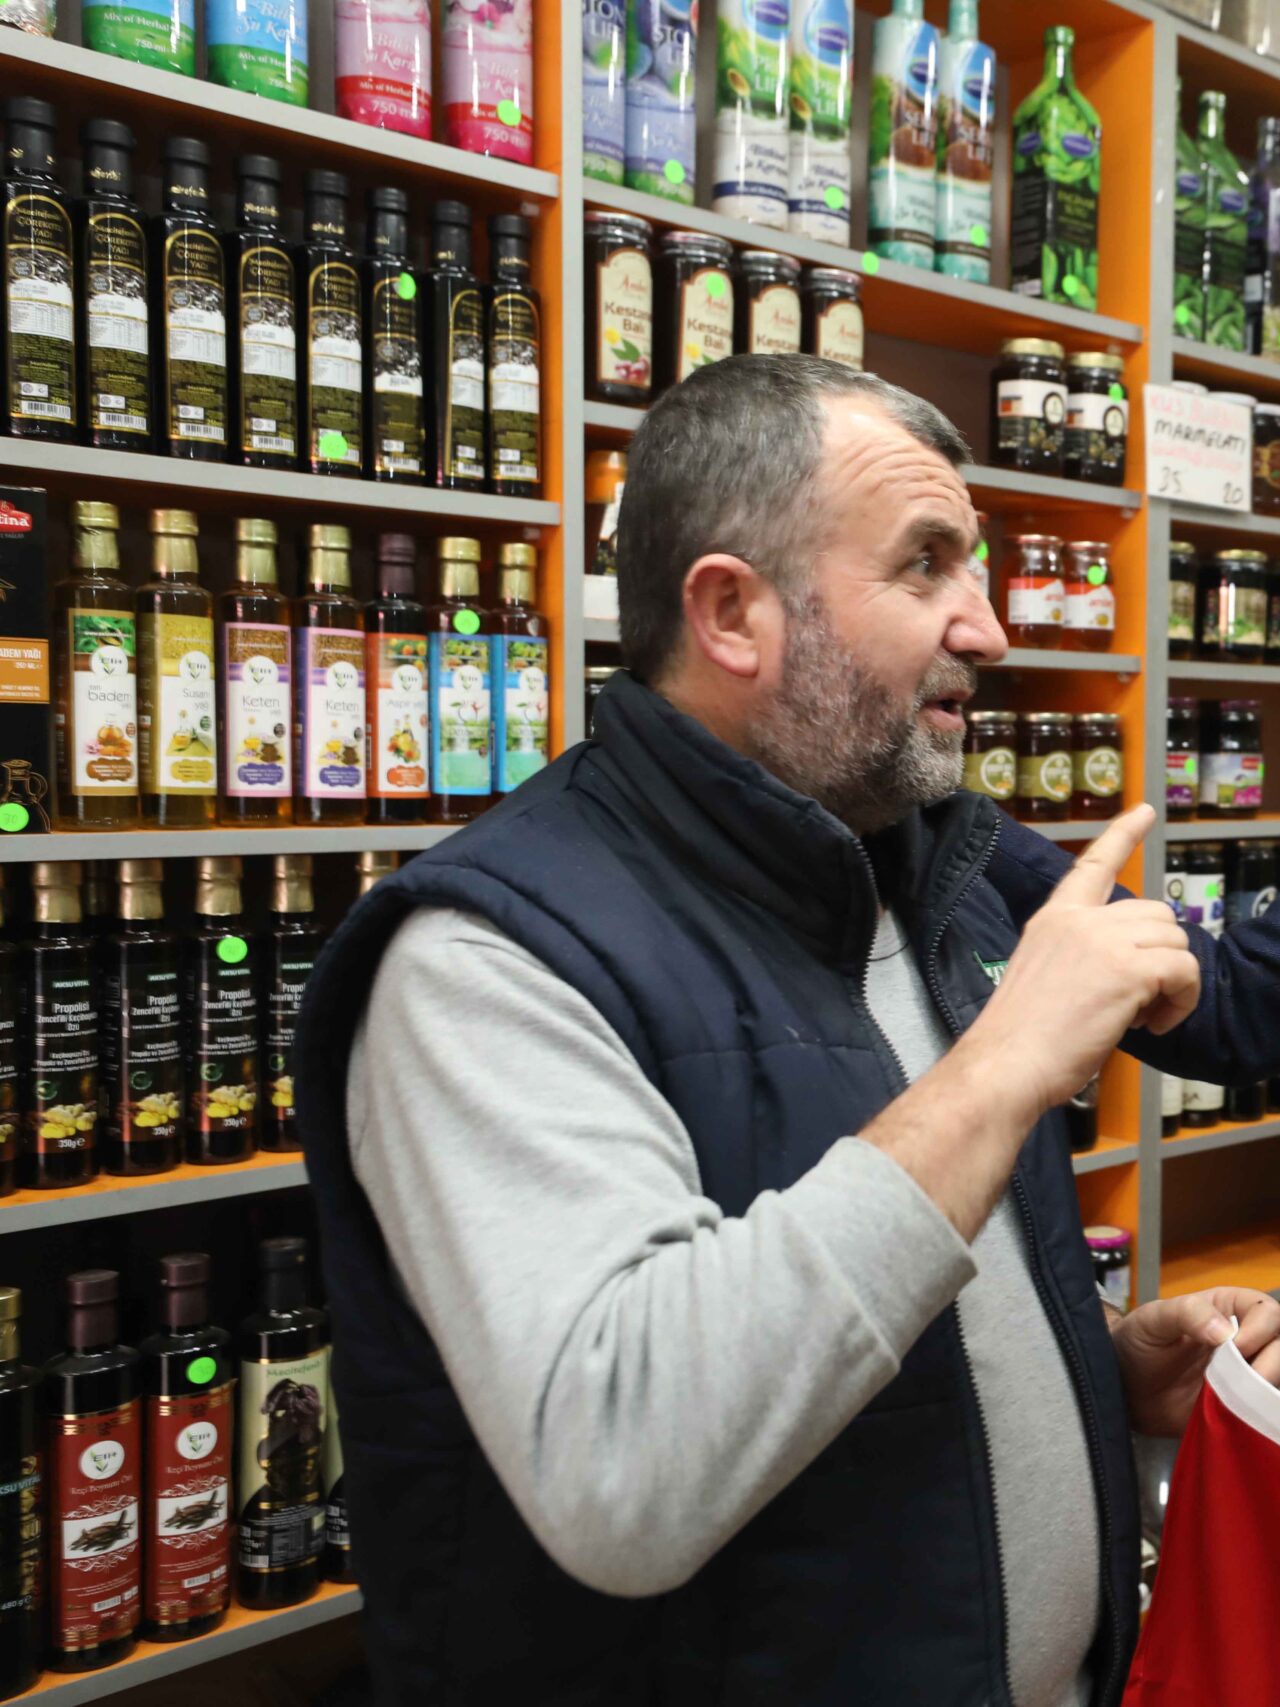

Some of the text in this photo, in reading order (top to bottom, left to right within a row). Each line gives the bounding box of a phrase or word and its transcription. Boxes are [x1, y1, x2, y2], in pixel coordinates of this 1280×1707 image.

[104, 12, 170, 32] Mix of Herbal
[371, 101, 397, 115] 750
[483, 127, 508, 142] 750
[0, 649, 21, 659] ADEM
[88, 690, 132, 702] badem
[242, 695, 280, 709] Keten
[326, 699, 360, 713] Keten
